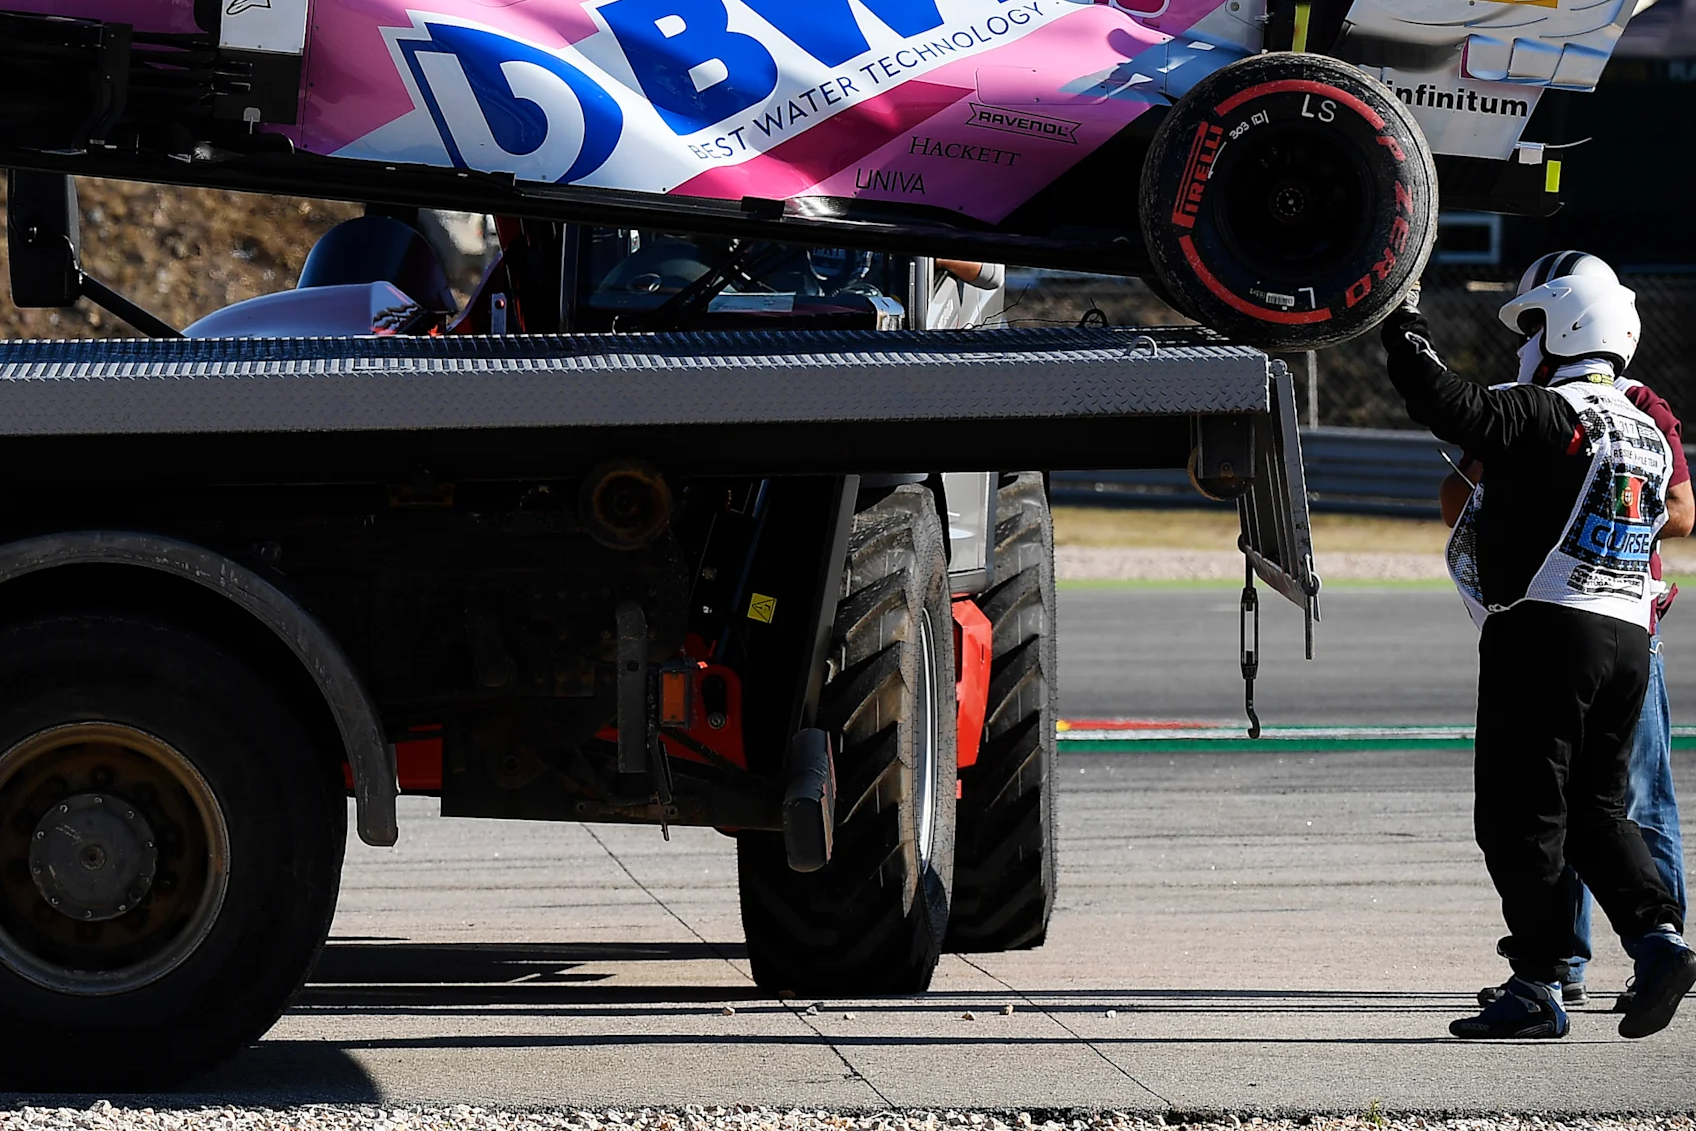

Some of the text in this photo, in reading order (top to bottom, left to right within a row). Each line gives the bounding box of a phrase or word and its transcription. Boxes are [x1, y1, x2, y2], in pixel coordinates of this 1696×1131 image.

[688, 1, 1045, 160] BEST WATER TECHNOLOGY
[1387, 80, 1528, 118] infinitum
[977, 111, 1069, 137] RAVENOL
[855, 168, 926, 195] UNIVA
[1172, 121, 1224, 229] PIRELLI
[1346, 180, 1414, 308] ZERO
[1591, 524, 1650, 554] CURSE
